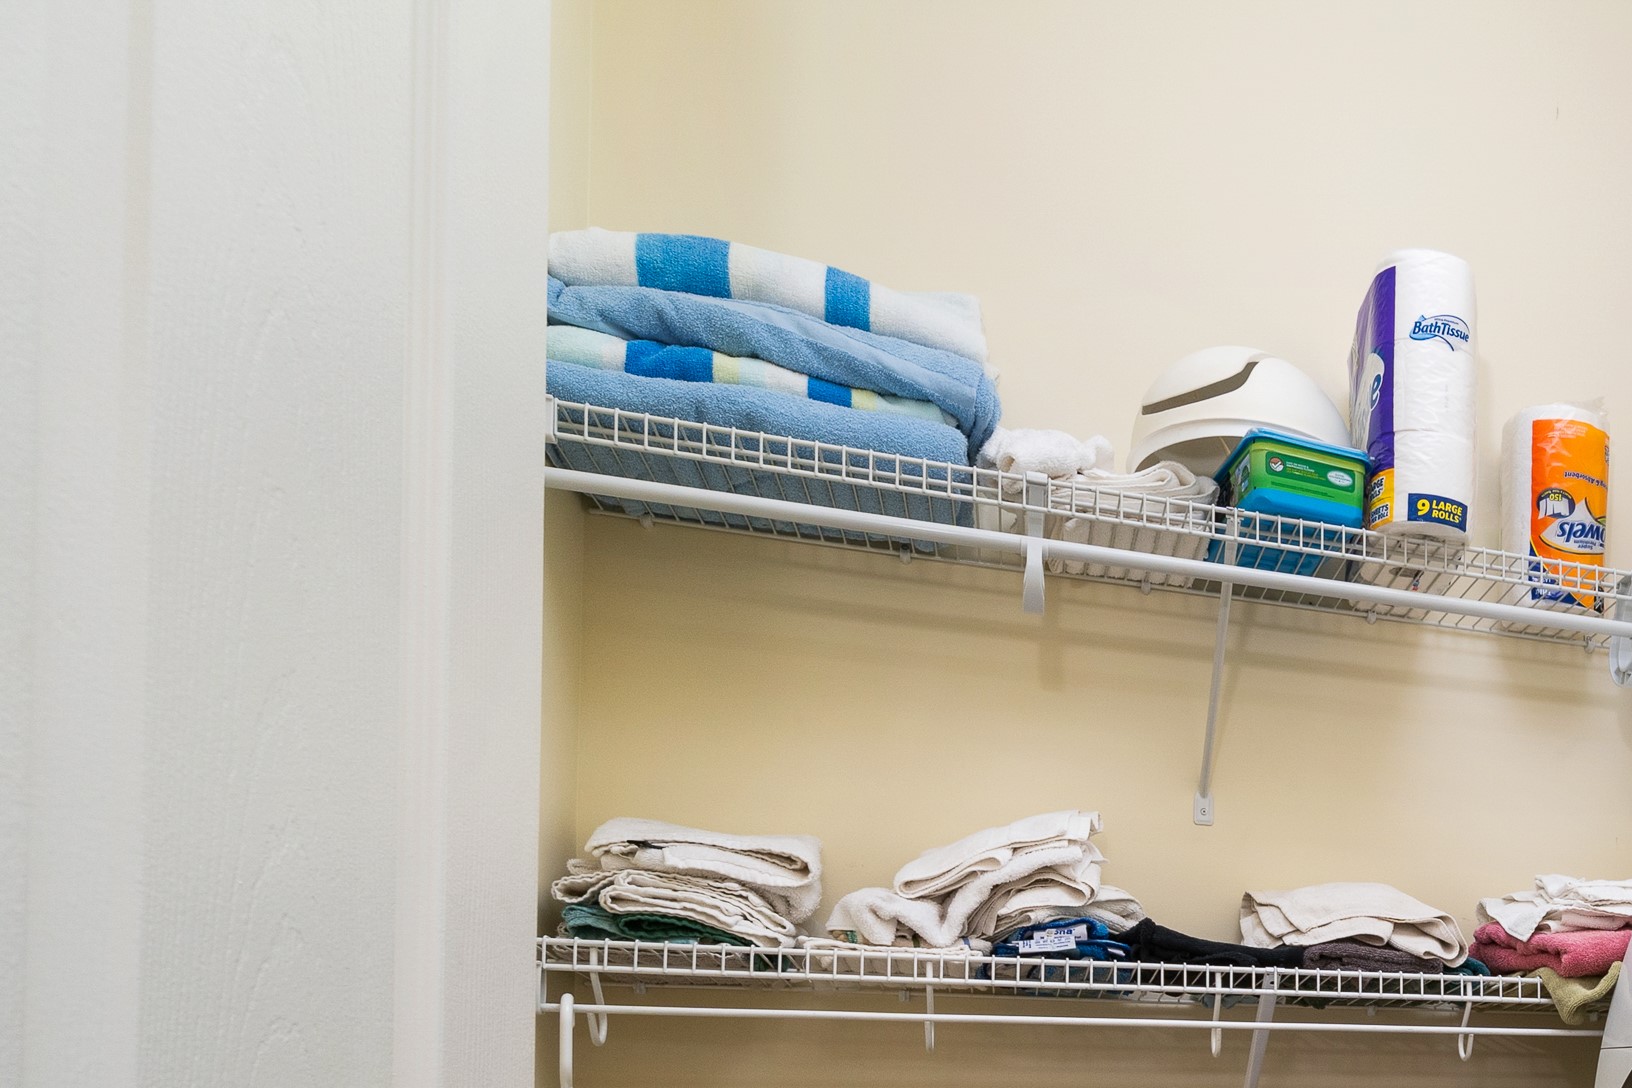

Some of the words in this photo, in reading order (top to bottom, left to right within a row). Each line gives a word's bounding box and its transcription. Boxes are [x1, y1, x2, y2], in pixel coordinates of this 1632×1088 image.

[1416, 499, 1430, 516] 9
[1432, 500, 1462, 516] LARGE
[1432, 510, 1460, 524] ROLLS
